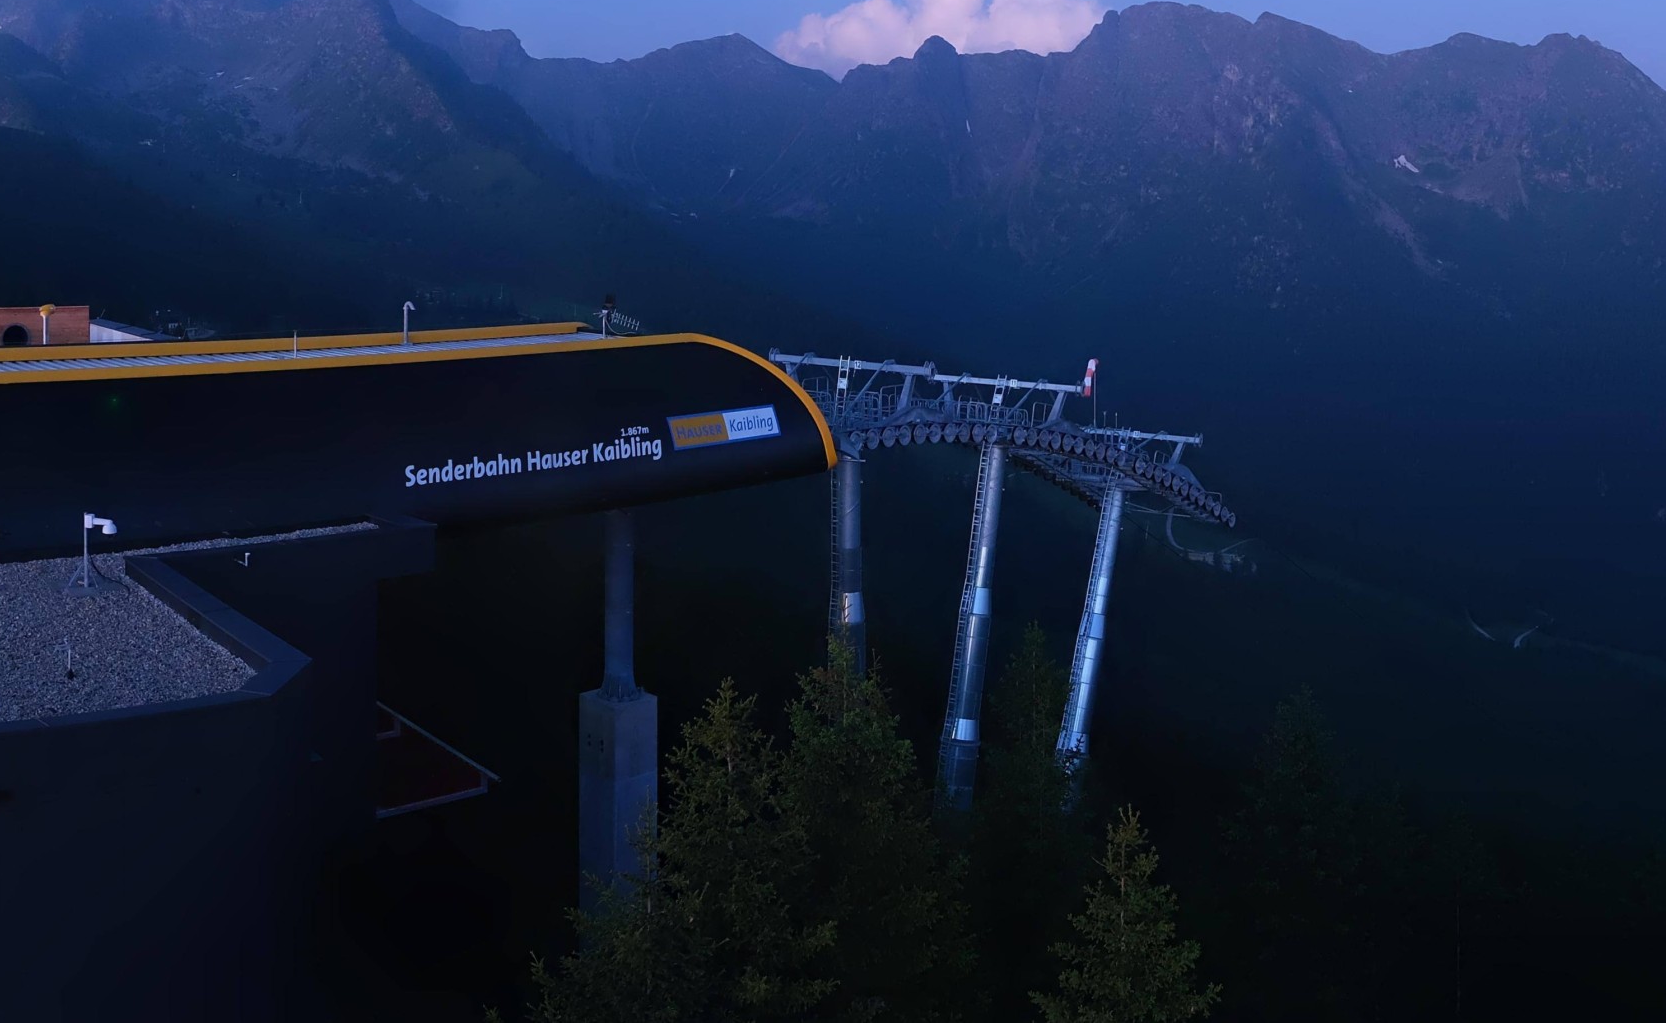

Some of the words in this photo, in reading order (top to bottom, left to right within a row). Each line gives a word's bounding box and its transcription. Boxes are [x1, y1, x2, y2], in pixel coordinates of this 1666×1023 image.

[620, 426, 650, 437] 1.867m
[676, 422, 723, 440] HAUSER
[729, 413, 775, 435] Kaibling
[404, 453, 522, 488] Senderbahn
[526, 447, 589, 472] Hauser
[592, 435, 663, 463] Kaibling
